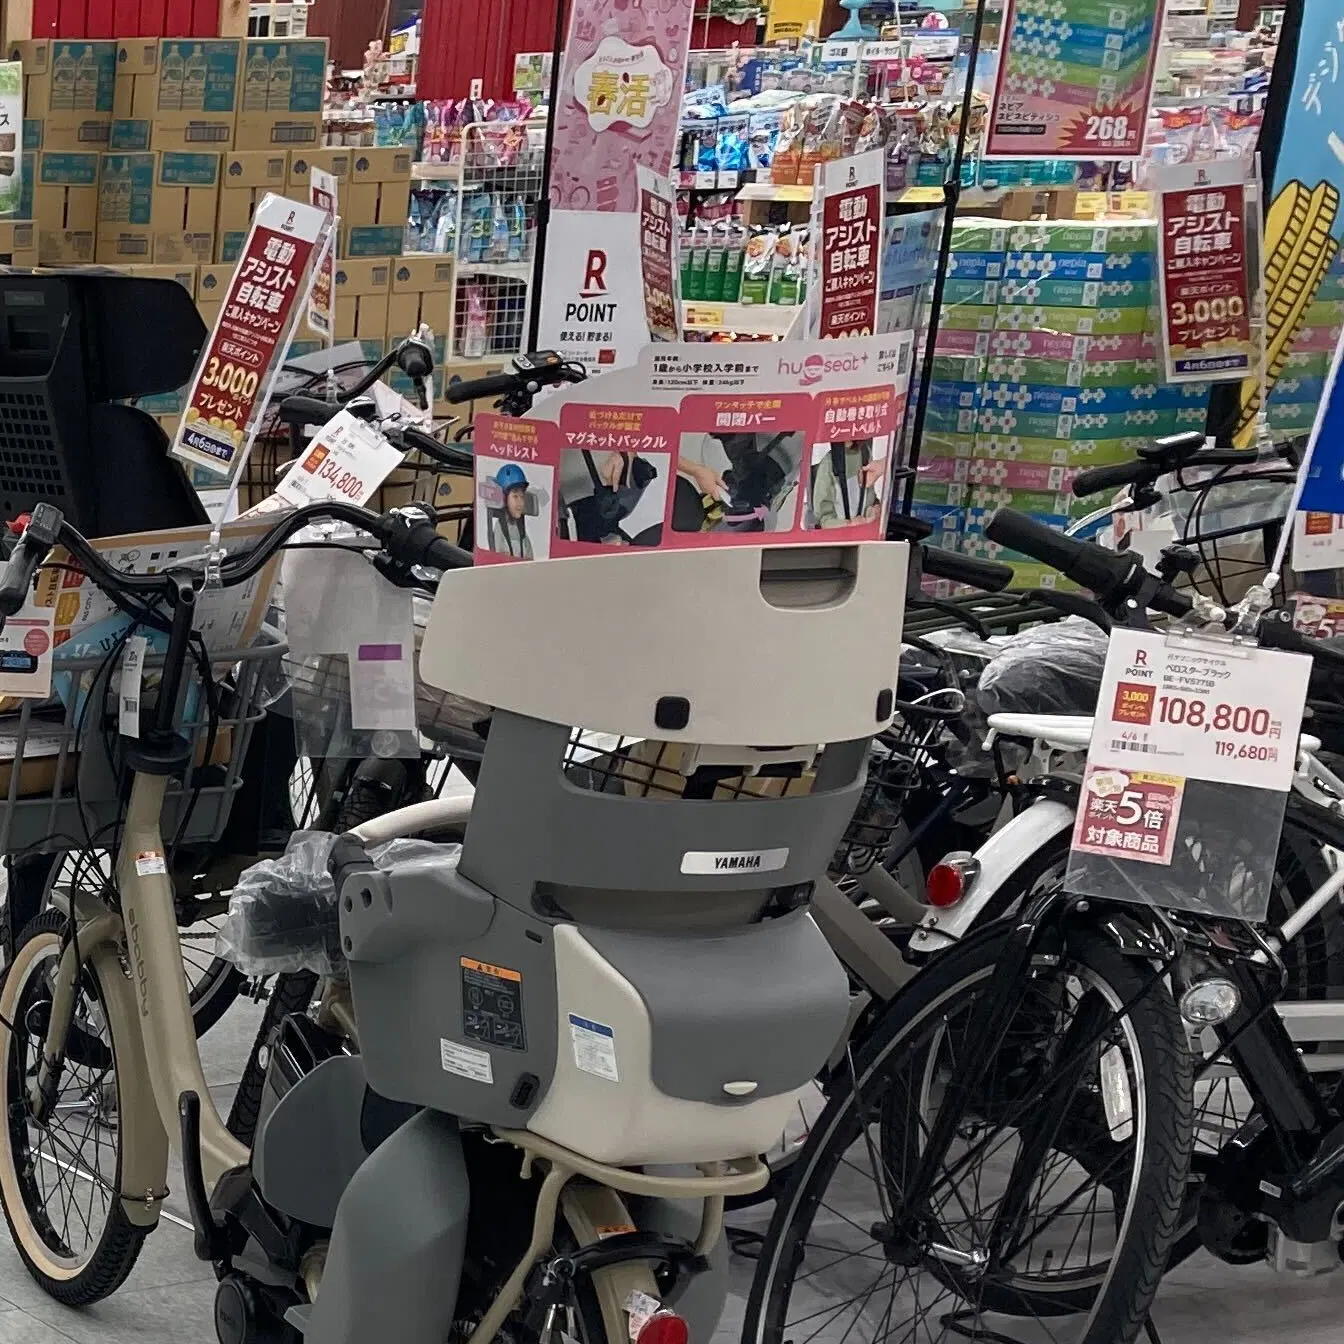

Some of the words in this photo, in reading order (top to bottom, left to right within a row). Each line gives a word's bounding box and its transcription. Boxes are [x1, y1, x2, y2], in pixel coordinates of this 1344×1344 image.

[999, 102, 1024, 111] ネピア
[1085, 116, 1129, 140] 268
[839, 195, 868, 222] 電動
[1186, 192, 1226, 214] 電動
[825, 218, 877, 251] アシスト
[1167, 211, 1240, 236] アシスト
[264, 236, 297, 265] 電動
[1174, 232, 1232, 256] 自転車
[830, 244, 871, 274] 自転車
[240, 256, 296, 291] アシスト
[579, 249, 609, 298] R
[235, 281, 285, 314] 自転車
[565, 303, 617, 323] POINT
[1171, 296, 1244, 326] 3,000
[1178, 324, 1240, 341] プレゼント
[219, 340, 260, 363] 楽天ポイント
[202, 356, 259, 400] 3,000
[653, 362, 760, 374] 1歳から小学校入学前まで
[199, 392, 244, 421] プレゼント
[824, 403, 889, 424] 自動巻き取り式
[716, 412, 777, 427] 開閉バー
[830, 421, 883, 439] シートベルト
[489, 442, 539, 461] ヘッドレスト
[565, 431, 667, 449] マグネットバックル
[317, 459, 363, 499] 134,800
[1125, 668, 1154, 679] POINT
[1165, 664, 1232, 680] ベロスターブラック
[1123, 690, 1149, 701] 3,000
[1159, 696, 1270, 736] 108,800
[1215, 740, 1268, 761] 119,680
[1090, 797, 1119, 815] 楽天
[1116, 791, 1143, 825] 5
[1144, 809, 1164, 830] 倍
[1086, 825, 1159, 853] 対象商品
[714, 855, 761, 870] YAMAHA
